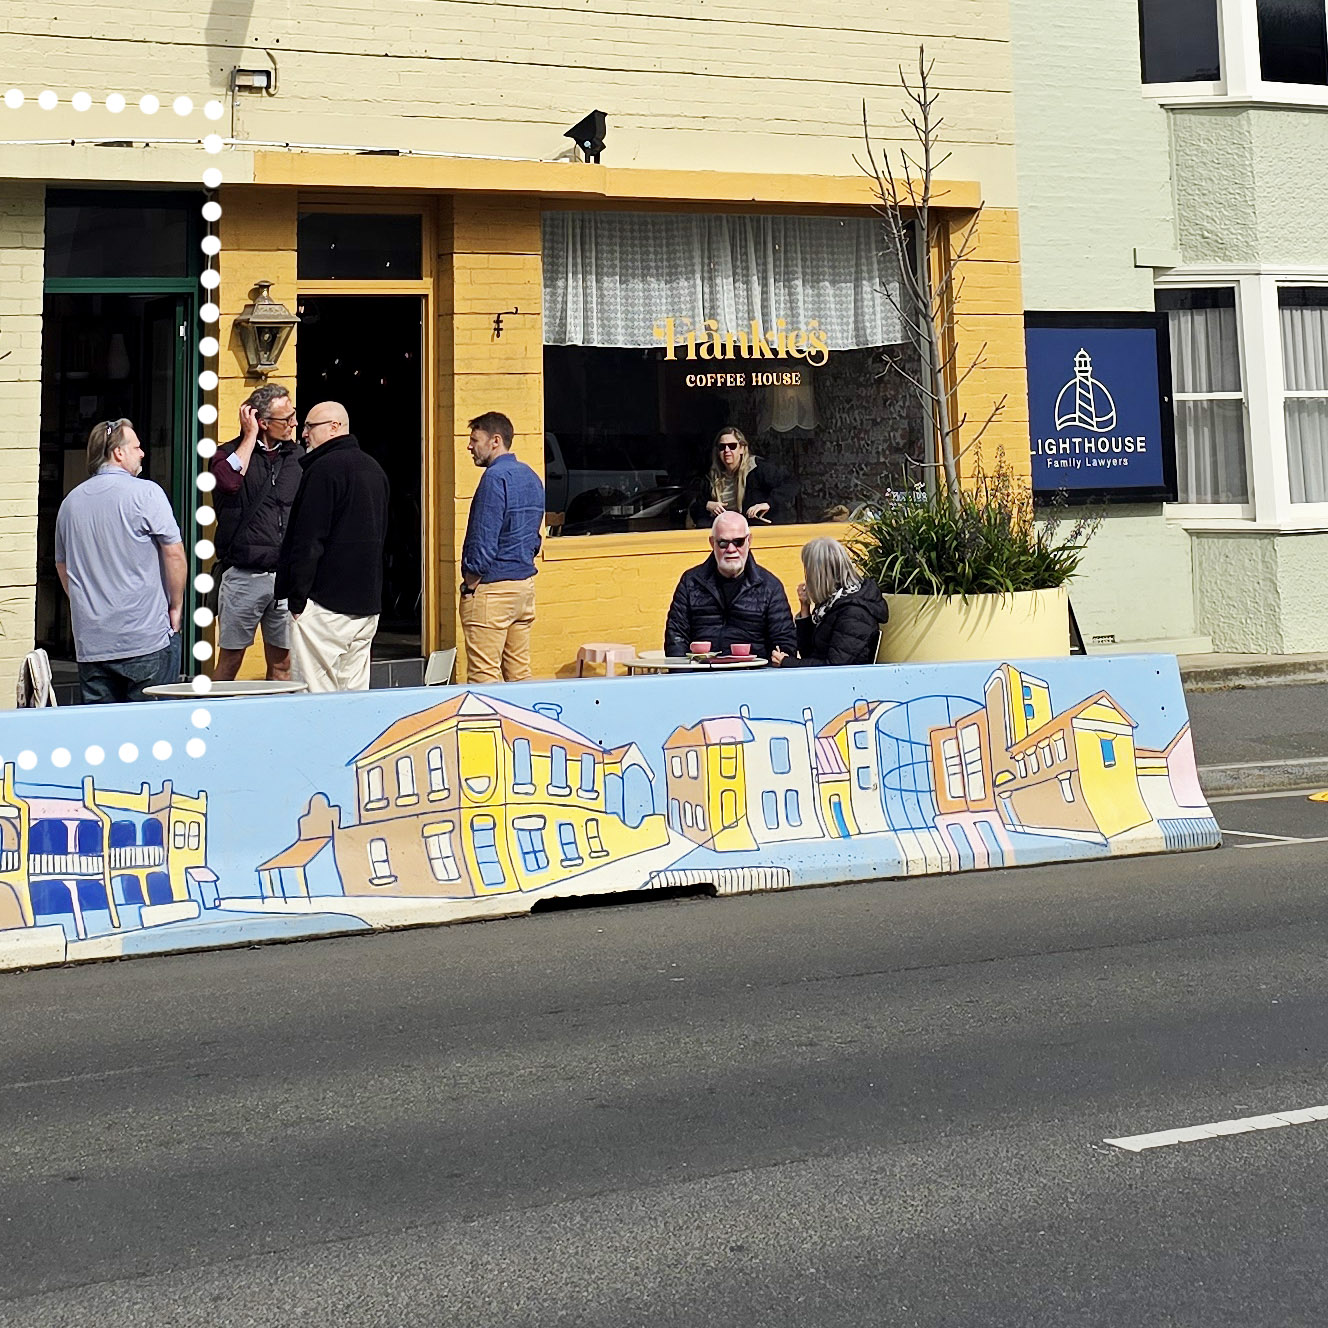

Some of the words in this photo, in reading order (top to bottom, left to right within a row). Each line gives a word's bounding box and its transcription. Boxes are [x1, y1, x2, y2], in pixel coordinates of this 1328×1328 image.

[686, 373, 746, 387] COFFEE
[751, 372, 801, 386] HOUSE
[1046, 458, 1082, 469] Family
[1085, 457, 1129, 469] Lawyers
